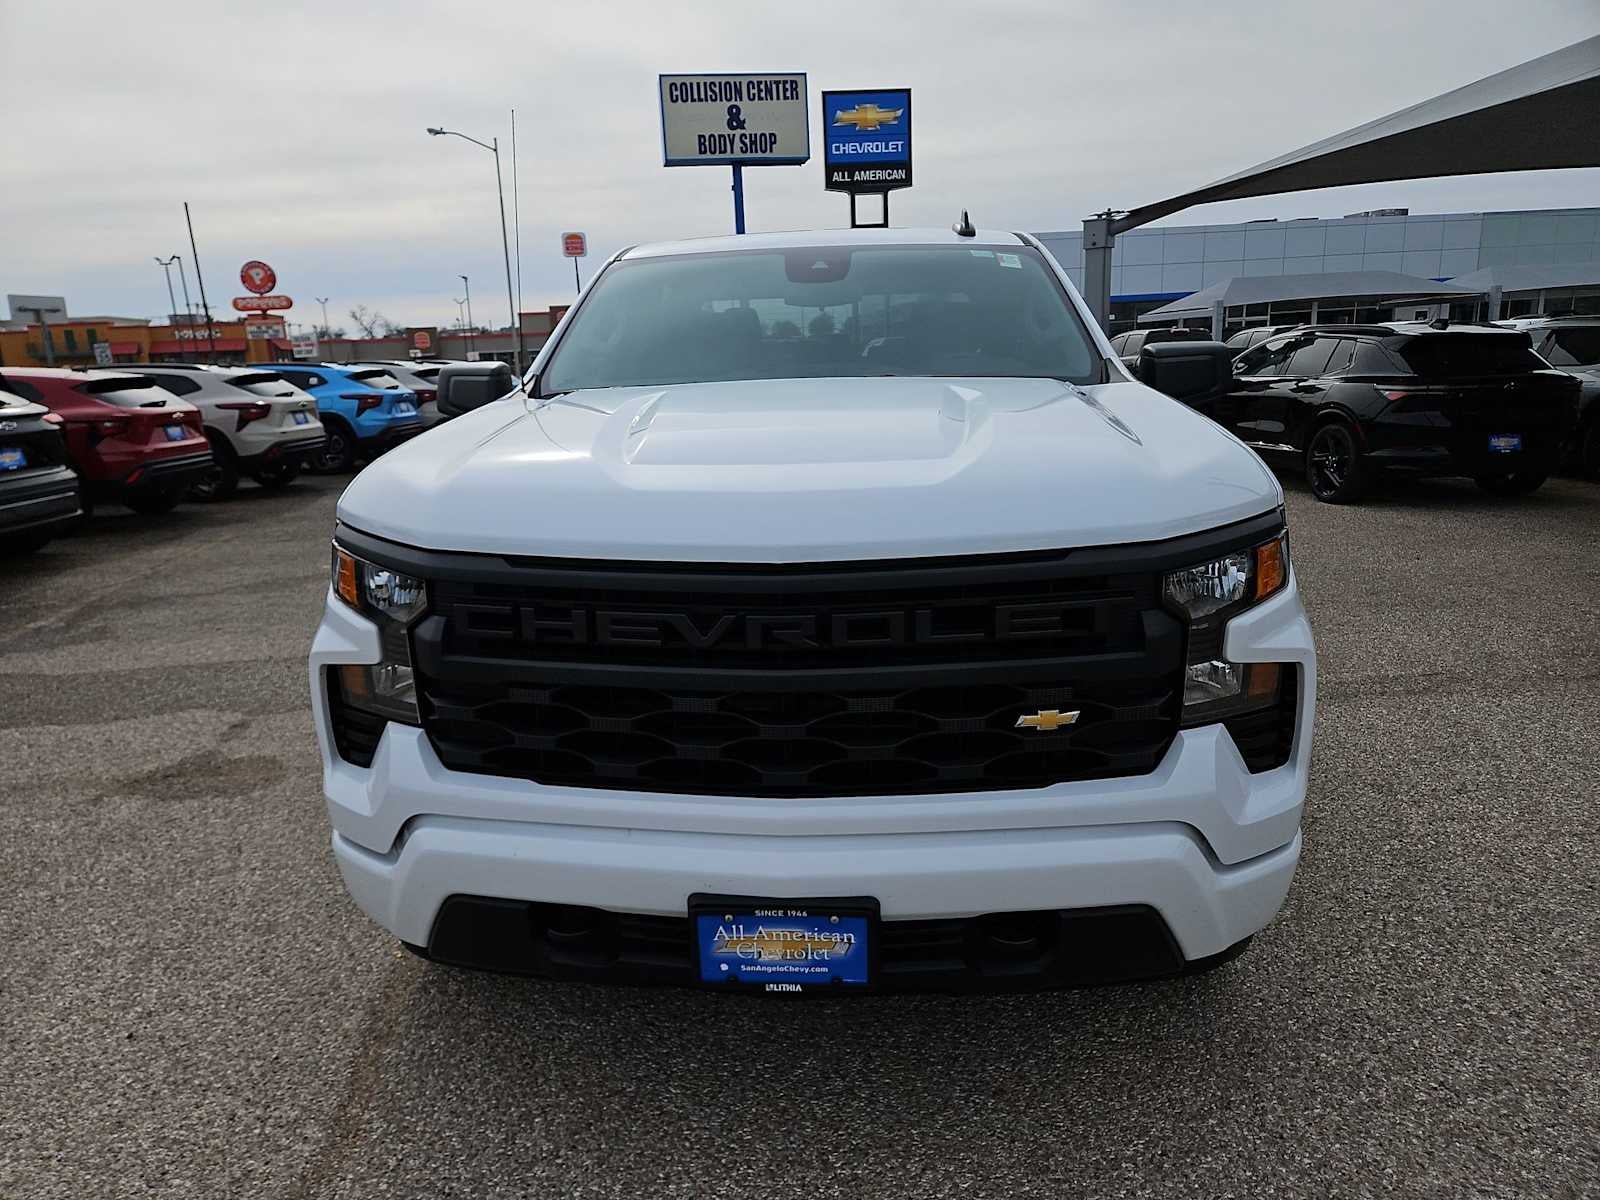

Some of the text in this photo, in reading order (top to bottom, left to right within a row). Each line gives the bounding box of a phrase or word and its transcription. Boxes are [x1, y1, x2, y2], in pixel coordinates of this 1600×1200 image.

[669, 79, 799, 103] COLLISION CENTER
[726, 104, 746, 130] &
[697, 132, 777, 155] BODY SHOP
[831, 141, 904, 154] CHEVROLET
[832, 169, 906, 182] ALL AMERICAN
[713, 925, 856, 944] All American
[736, 942, 831, 961] Chevrolet
[741, 964, 829, 973] SanAngeloChevy.com
[773, 983, 803, 992] LITHIA
